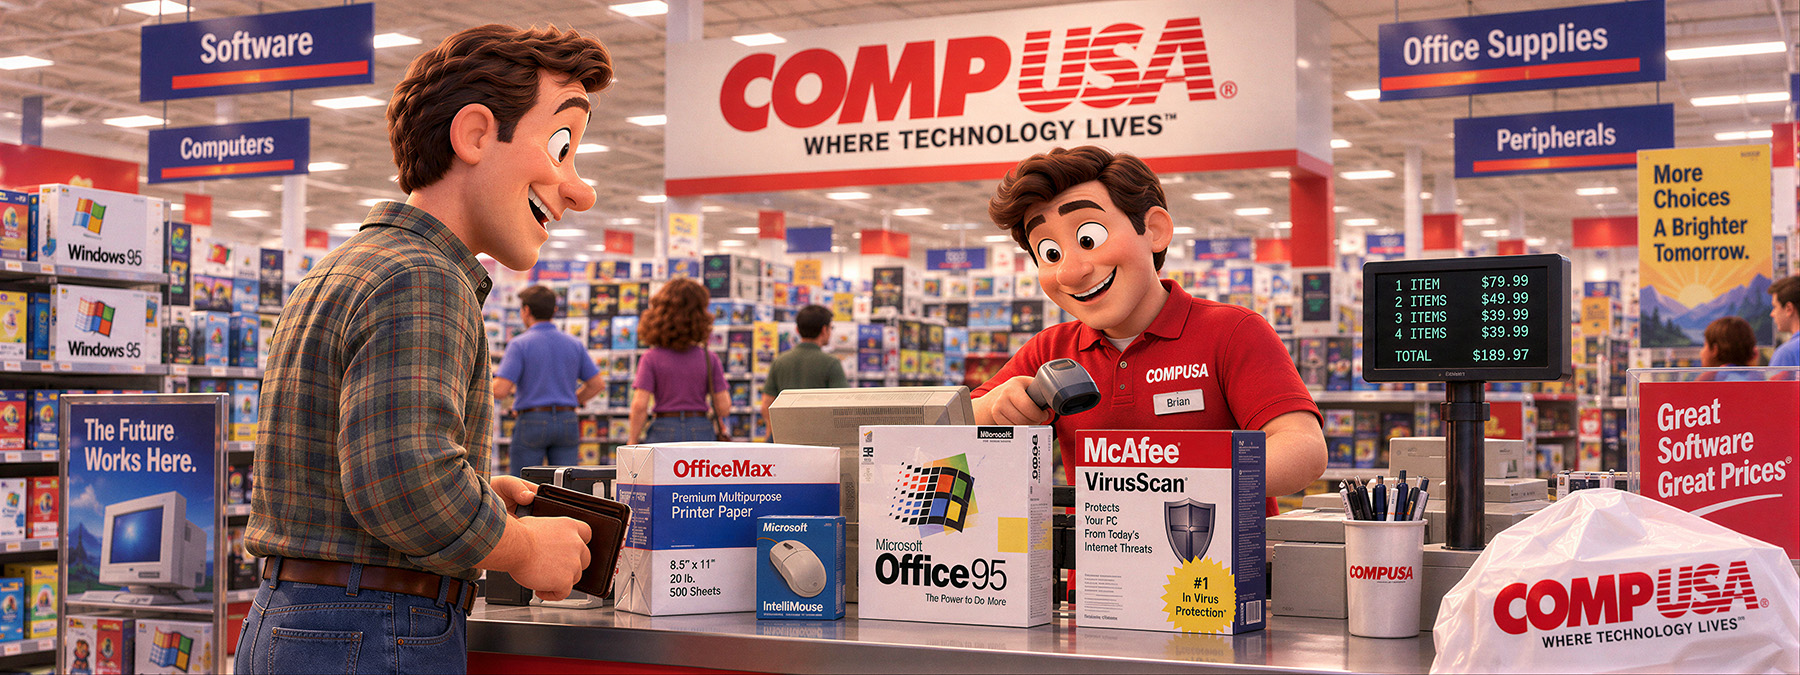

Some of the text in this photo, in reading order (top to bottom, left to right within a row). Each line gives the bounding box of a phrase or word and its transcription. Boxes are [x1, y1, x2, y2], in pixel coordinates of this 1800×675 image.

[200, 31, 314, 65] Software
[1403, 23, 1608, 66] Office Supplies
[804, 131, 890, 156] WHERE
[899, 120, 1076, 150] TECHNOLOGY
[1497, 123, 1616, 154] Peripherals
[180, 134, 275, 163] Computers
[1653, 164, 1703, 184] More
[1653, 188, 1730, 209] Choices
[1653, 216, 1748, 239] A Brighter
[68, 244, 142, 266] Windows 95
[1653, 242, 1750, 263] Tomorrow.
[1395, 274, 1529, 291] 1 ITEM $79.99
[1395, 291, 1529, 308] 2 ITEMS $49.99
[1395, 308, 1529, 323] 3 ITEMS $39.99
[1395, 325, 1529, 340] 4 ITEMS $39.99
[68, 340, 141, 359] Windows 95
[1395, 348, 1529, 363] TOTAL $189.97
[1145, 363, 1209, 384] COMPUSA
[1167, 396, 1191, 408] Brian
[1657, 398, 1721, 432] Great
[84, 418, 174, 443] The Future
[1084, 436, 1180, 464] McAfee
[1657, 431, 1754, 464] Software
[85, 447, 197, 473] Works Here.
[673, 459, 774, 478] OfficeMax
[1085, 472, 1185, 493] VirusScan
[1657, 467, 1716, 498] Great
[672, 491, 782, 505] Premium Multipurpose
[671, 506, 753, 520] Printer Paper
[1084, 502, 1120, 513] Protects
[763, 522, 808, 532] Microsoft
[1085, 515, 1118, 526] Your PC
[1084, 529, 1140, 541] From Today's
[875, 538, 923, 552] Microsoft
[1084, 542, 1153, 554] Internet Threats
[692, 562, 698, 570] x
[875, 552, 1007, 591] Office 95
[1349, 565, 1414, 580] COMPUSA
[670, 574, 696, 584] 20 lb.
[1193, 577, 1208, 589] #1
[669, 586, 721, 598] 500 Sheets
[925, 593, 1007, 606] The Power to Do More
[1182, 592, 1219, 604] In Virus
[763, 600, 824, 612] IntelliMouse
[1541, 632, 1593, 649] WHERE
[1596, 622, 1693, 644] TECHNOLOGY
